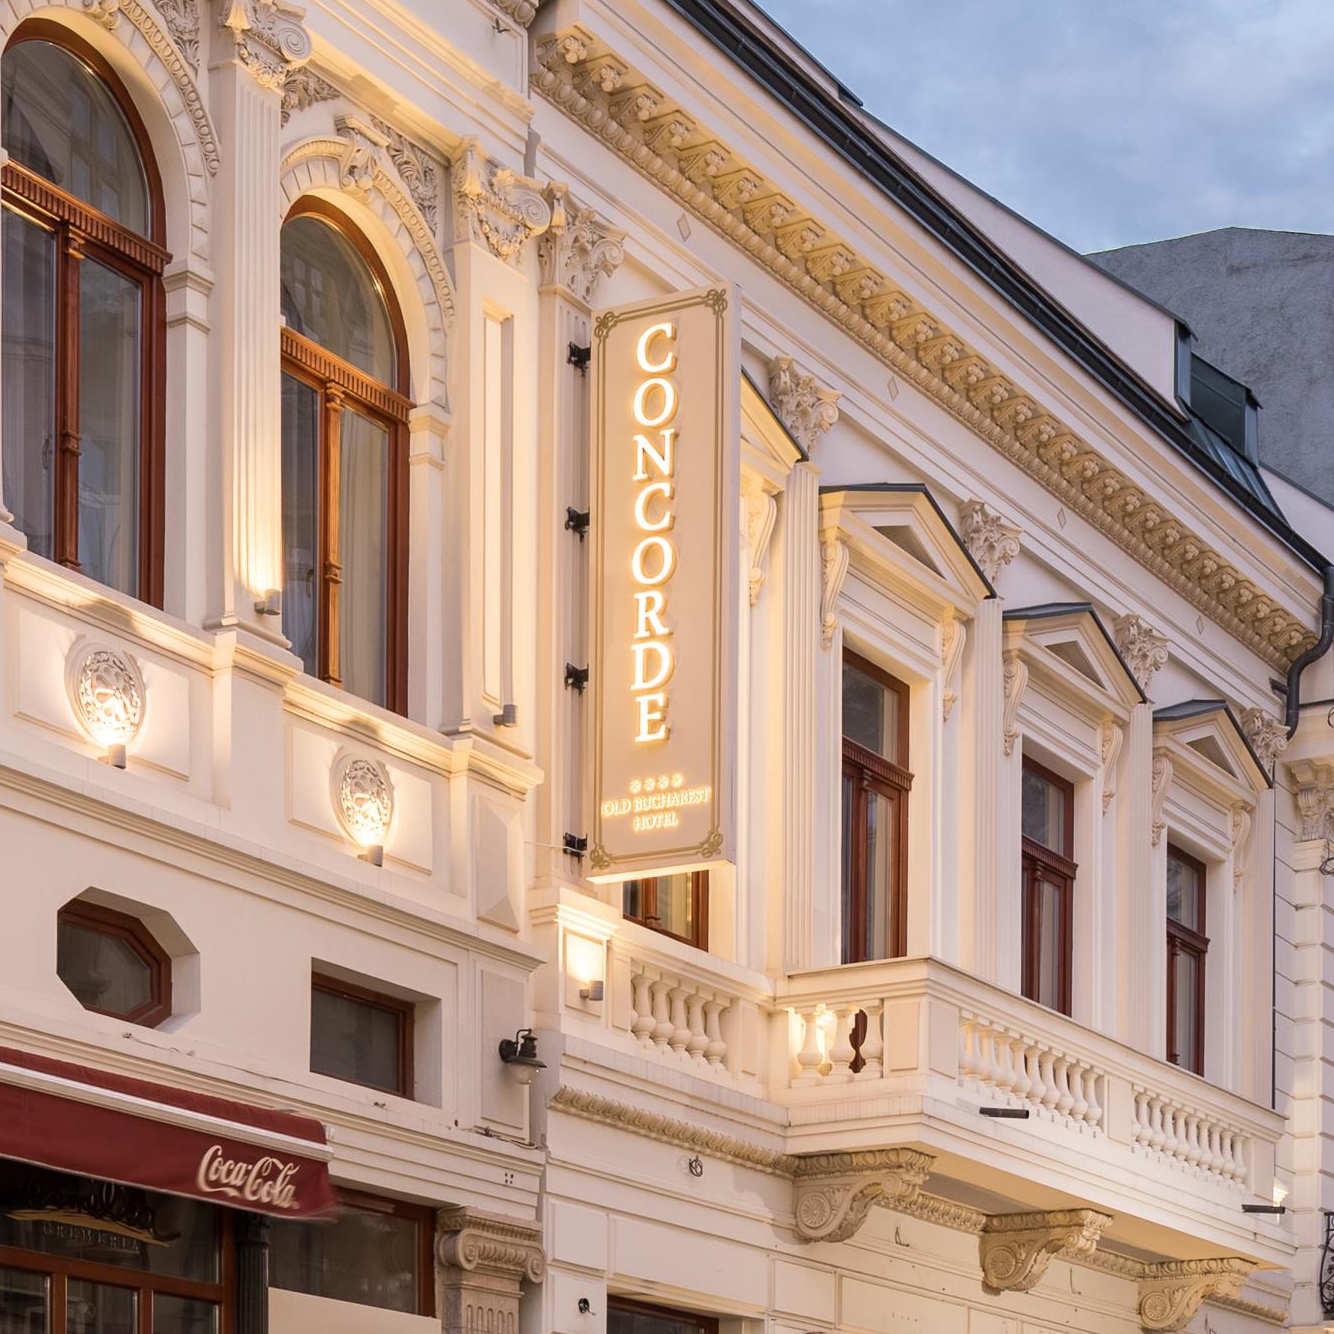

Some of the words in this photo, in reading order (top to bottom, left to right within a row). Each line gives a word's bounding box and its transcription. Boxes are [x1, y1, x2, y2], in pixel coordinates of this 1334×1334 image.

[630, 323, 677, 743] CONCORDE
[603, 799, 632, 816] OLD
[634, 787, 712, 813] BUCHAREST
[634, 811, 679, 832] HOTEL
[197, 1145, 300, 1208] Coca-Cola
